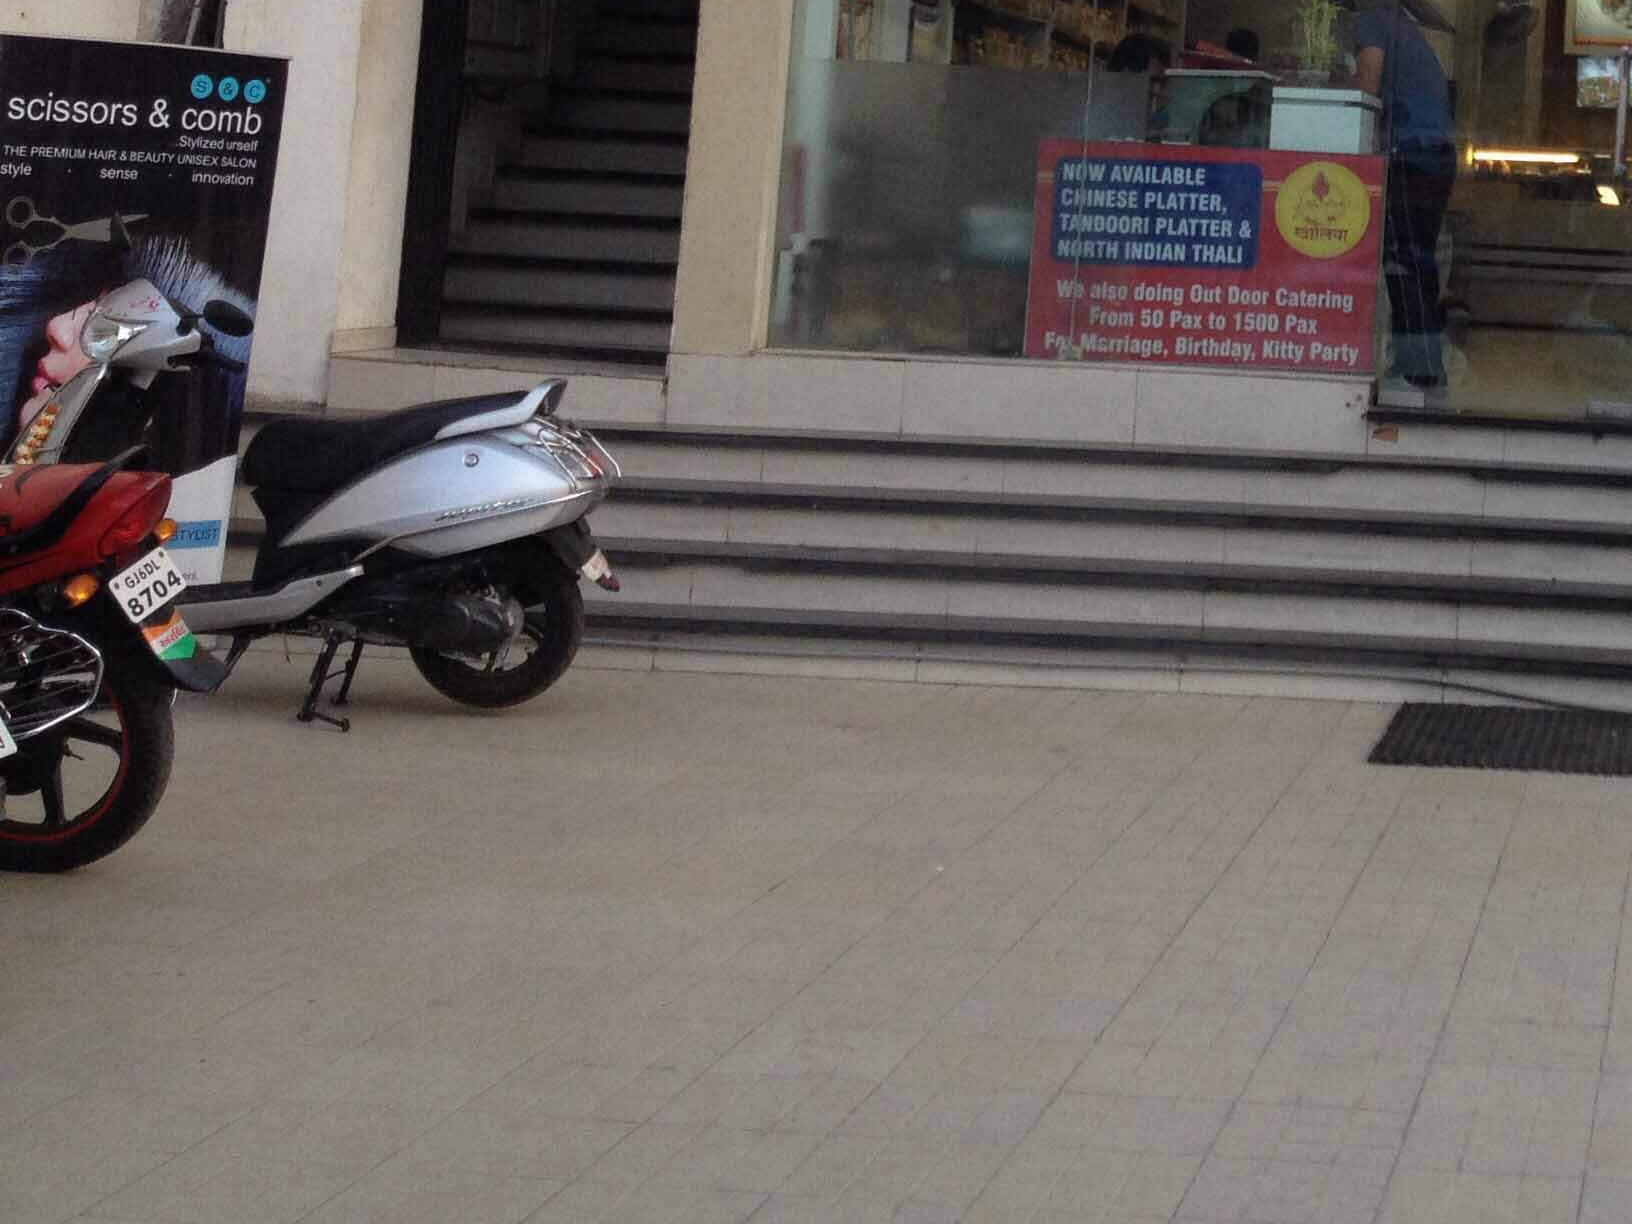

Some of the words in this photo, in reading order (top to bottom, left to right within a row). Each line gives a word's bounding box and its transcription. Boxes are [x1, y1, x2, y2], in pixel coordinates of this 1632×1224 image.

[7, 91, 138, 126] scissors
[149, 98, 170, 128] &
[181, 106, 262, 135] comb
[4, 144, 27, 157] THE
[30, 146, 86, 160] PREMIUM
[88, 149, 116, 161] HAIR
[119, 151, 127, 161] &
[130, 152, 174, 164] BEAUTY
[177, 155, 218, 167] UNISEX
[221, 157, 257, 169] SALON
[226, 138, 258, 152] urself
[0, 162, 33, 177] style
[99, 168, 138, 181] sense
[192, 170, 255, 185] innovation
[1062, 162, 1106, 181] NOW
[1110, 165, 1206, 186] AVAILABLE
[1060, 188, 1139, 209] CHINESE
[1144, 191, 1229, 215] PLATTER,
[1058, 213, 1150, 235] TANDOORI
[1155, 217, 1233, 238] PLATTER
[1239, 220, 1252, 239] &
[1057, 239, 1120, 260] NORTH
[1125, 242, 1186, 262] INDIAN
[1192, 244, 1243, 264] THALI
[1056, 279, 1084, 298] We
[1089, 281, 1128, 300] also
[1134, 282, 1184, 306] doing
[1190, 284, 1221, 303] Out
[1228, 286, 1269, 305] Door
[1275, 288, 1354, 312] Catering
[1089, 306, 1134, 326] From
[1140, 308, 1164, 328] 50
[1170, 310, 1202, 329] Pax
[1207, 312, 1227, 330] to
[1233, 313, 1280, 332] 1500
[1285, 315, 1318, 334] Pax
[1080, 333, 1169, 358] Marriage,
[1175, 337, 1257, 362] Birthday,
[1263, 340, 1304, 363] Kitty
[1310, 342, 1359, 365] Party
[126, 569, 182, 618] 8704
